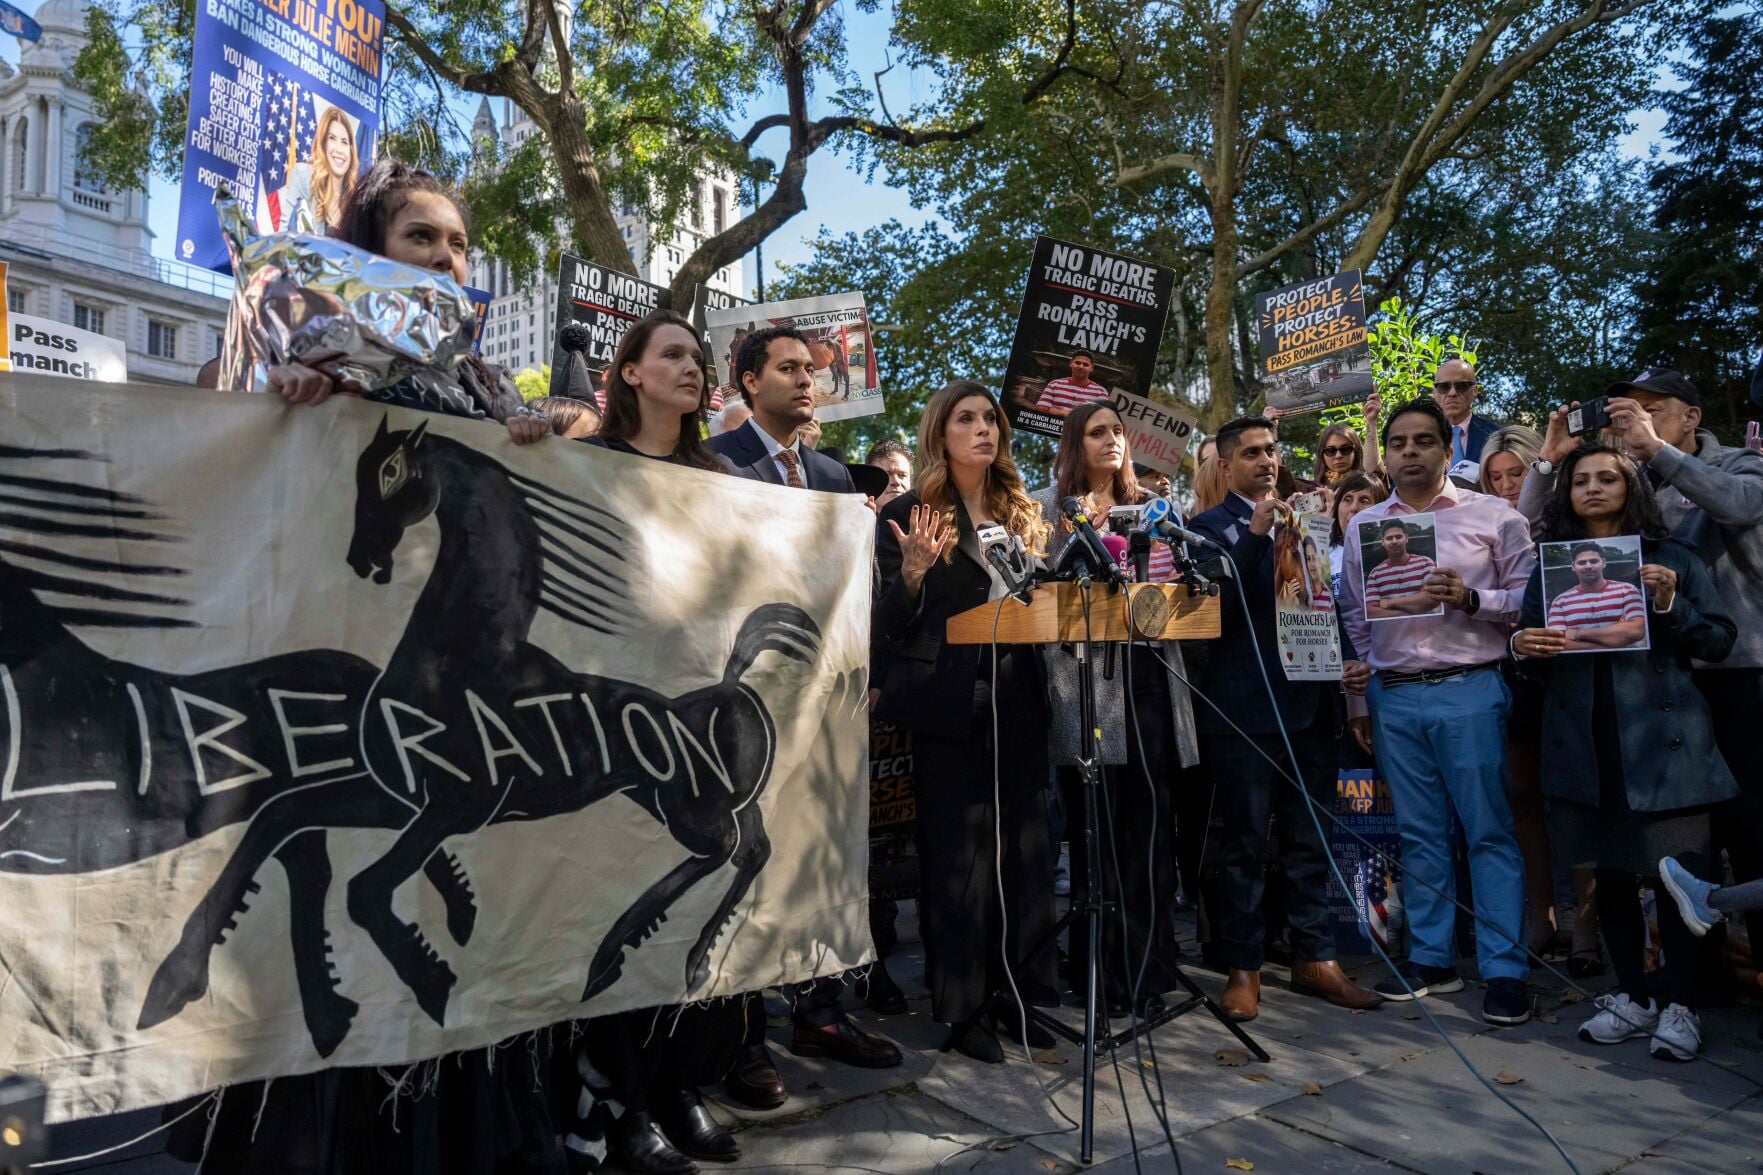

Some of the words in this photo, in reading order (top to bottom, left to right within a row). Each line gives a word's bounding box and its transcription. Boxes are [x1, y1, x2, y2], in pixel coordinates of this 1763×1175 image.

[257, 7, 264, 26] A
[265, 14, 319, 59] STRONG
[322, 48, 366, 89] WOMAN
[367, 78, 378, 97] TO
[292, 0, 333, 47] JULIE
[335, 25, 379, 78] MENIN
[206, 0, 239, 30] BAN
[241, 18, 300, 66] DANGEROUS
[300, 53, 330, 88] HORSE
[331, 76, 377, 114] CARRIAGES!
[223, 44, 242, 68] YOU
[244, 56, 264, 81] WILL
[210, 71, 249, 104] HISTORY
[250, 92, 263, 111] BY
[237, 69, 264, 96] MAKE
[209, 88, 254, 122] CREATING
[254, 111, 261, 127] A
[209, 105, 240, 132] SAFER
[191, 130, 211, 152] FOR
[212, 141, 258, 173] WORKERS
[199, 117, 236, 146] BETTER
[237, 135, 258, 157] JOBS
[198, 167, 255, 204] PROTCTING
[236, 168, 256, 188] AND
[1050, 243, 1084, 272] NO
[1090, 253, 1158, 291] MORE
[570, 283, 615, 309] TRAGIC
[575, 263, 602, 289] NO
[607, 271, 659, 309] MORE
[707, 290, 730, 310] NO
[1044, 265, 1098, 292] TRAGIC
[1100, 280, 1159, 309] DEATHS,
[1266, 277, 1335, 312] PROTECT
[596, 311, 634, 333] PASS
[796, 315, 826, 328] ABUSE
[827, 311, 859, 325] VICTIM
[1038, 302, 1147, 344] ROMANCH'S
[1071, 294, 1119, 319] PASS
[1274, 303, 1344, 338] PROTECT
[15, 323, 78, 353] Pass
[1057, 325, 1120, 356] LAW!
[1270, 353, 1292, 369] PASS
[1293, 338, 1344, 362] ROMANCH'S
[1346, 330, 1363, 344] LAW
[1278, 315, 1357, 351] HORSES:
[590, 340, 617, 363] LA
[1019, 410, 1049, 422] ROMANCH
[1030, 419, 1061, 432] CARRIAGE
[1115, 393, 1190, 438] DEFEND
[1291, 629, 1303, 637] FOR
[1304, 629, 1331, 637] ROMANCH
[1296, 638, 1307, 646] FOR
[1307, 638, 1328, 646] HORSES
[1, 664, 736, 799] LIBERATION
